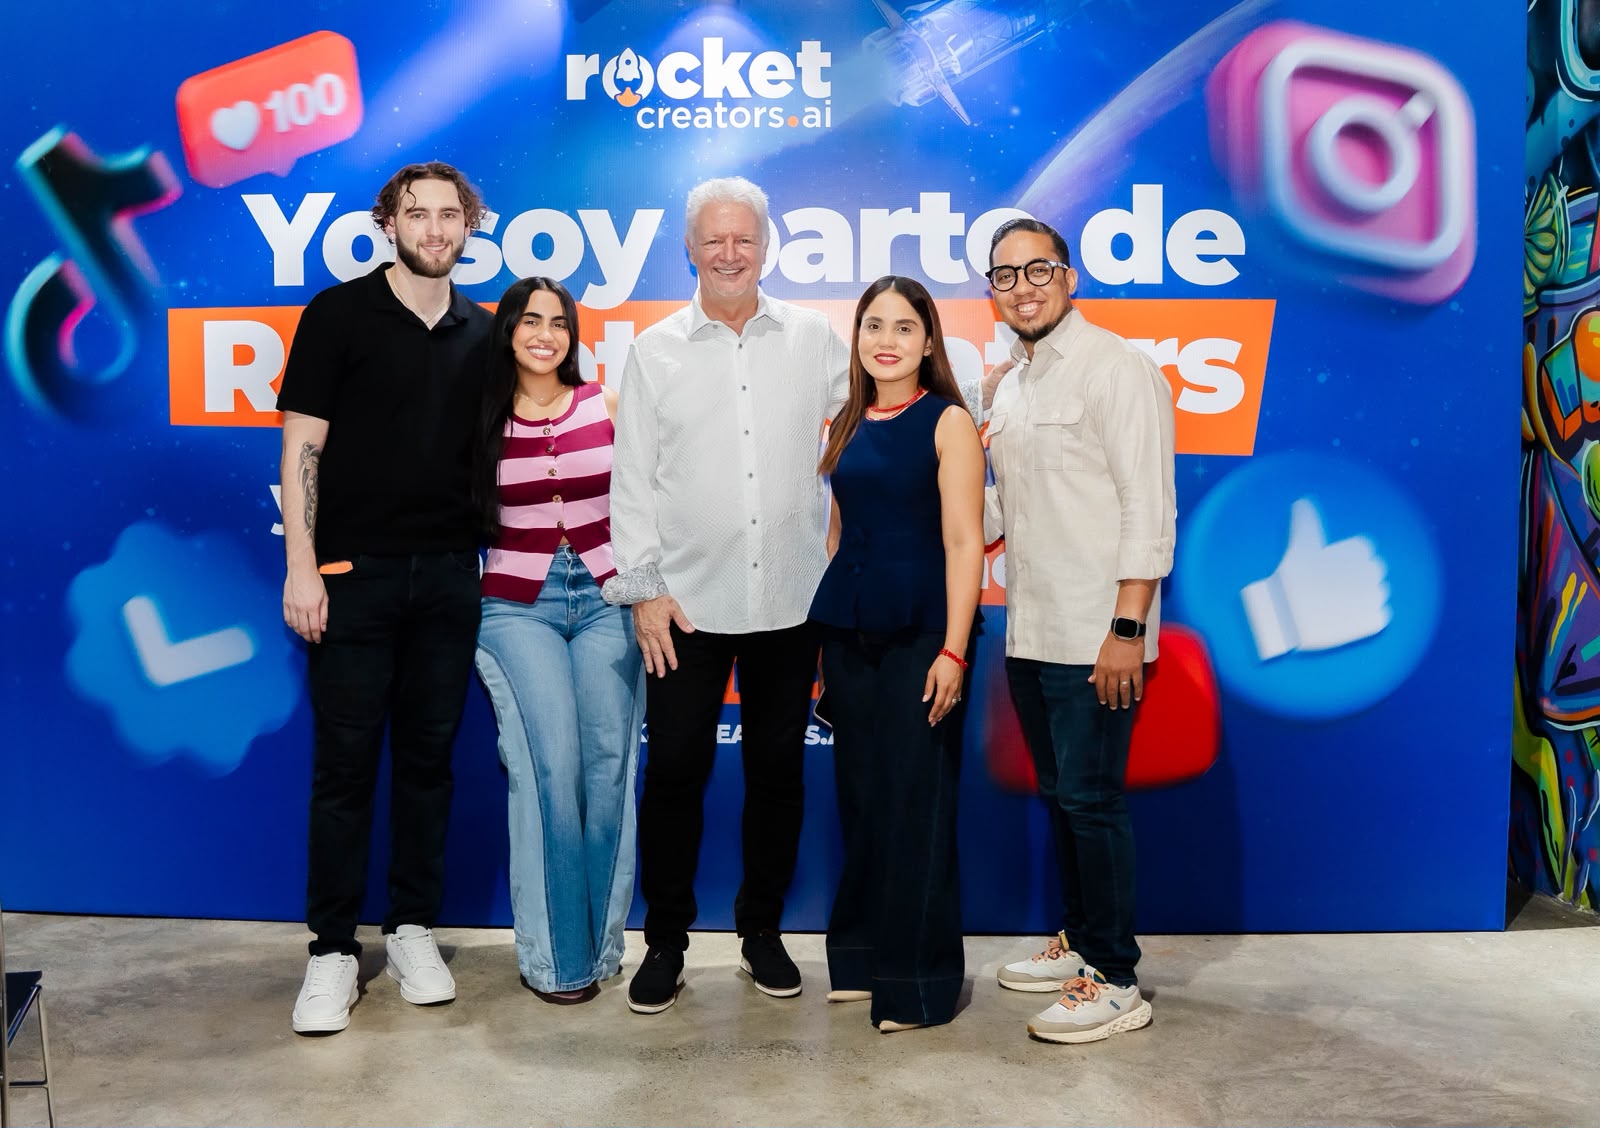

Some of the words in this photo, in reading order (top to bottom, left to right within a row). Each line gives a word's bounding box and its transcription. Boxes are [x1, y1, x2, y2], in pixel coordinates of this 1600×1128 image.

[264, 72, 347, 133] 100
[566, 36, 832, 107] rocket
[636, 100, 832, 130] creators.ai
[241, 192, 397, 287] Yo
[1080, 183, 1246, 286] de
